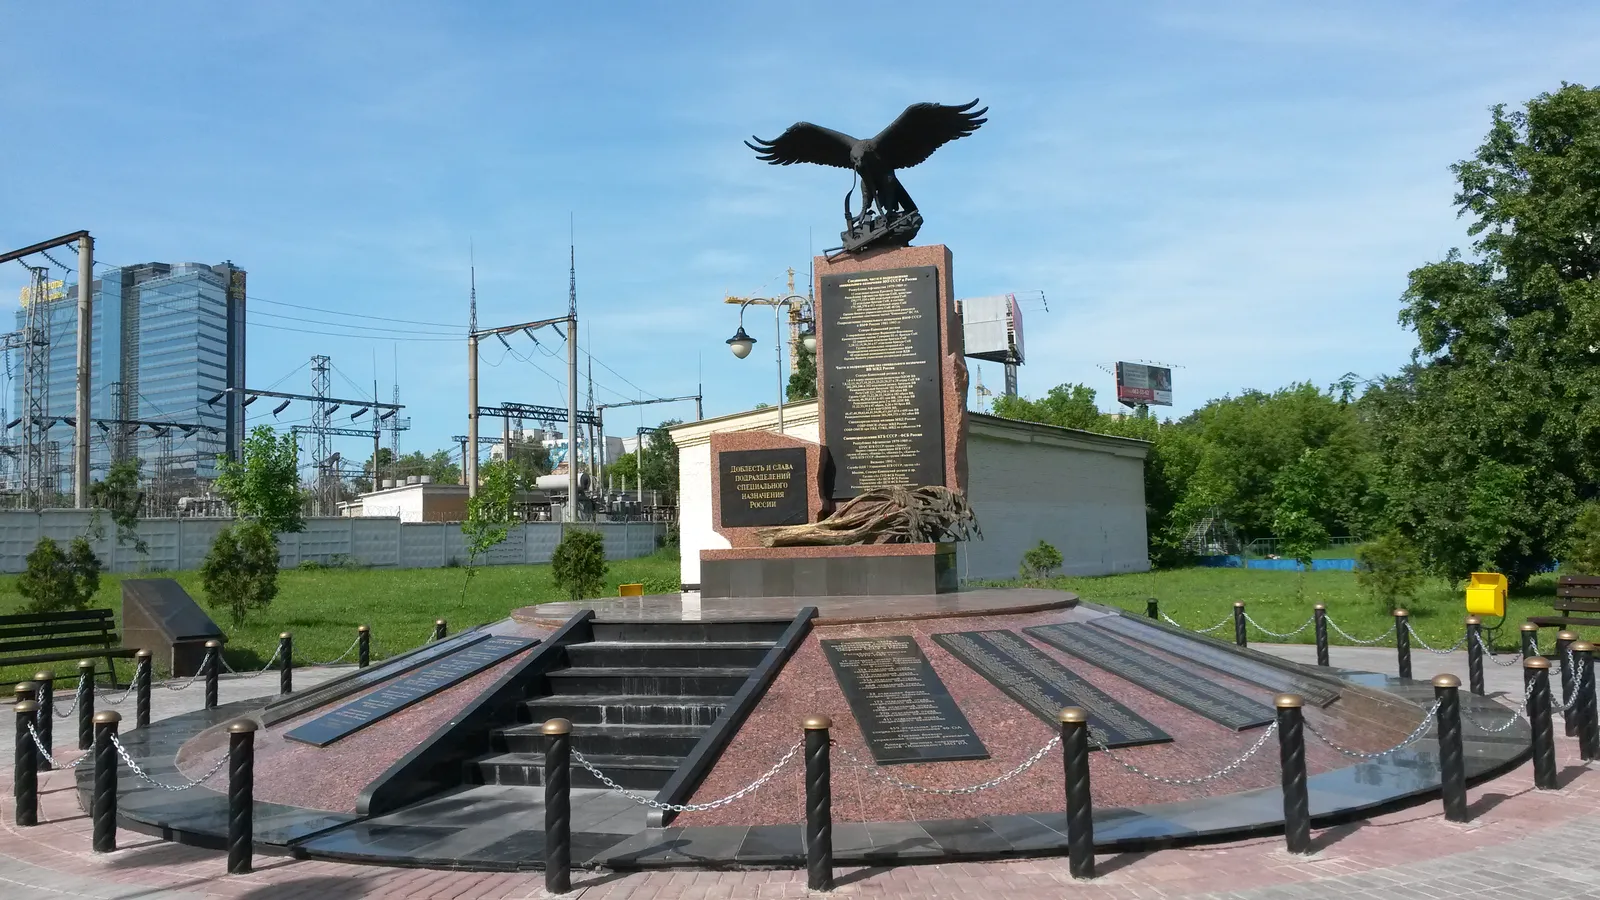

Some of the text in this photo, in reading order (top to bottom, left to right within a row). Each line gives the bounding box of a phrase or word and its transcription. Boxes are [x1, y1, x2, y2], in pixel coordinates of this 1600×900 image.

[730, 465, 765, 473] ДОБЛЕСТЬ
[735, 471, 791, 481] ПОДРАЗДЕЛЕНИЙ
[736, 482, 788, 490] СПЕЦИАЛЬНОГО
[741, 491, 785, 499] НАЗНАЧЕНИЯ
